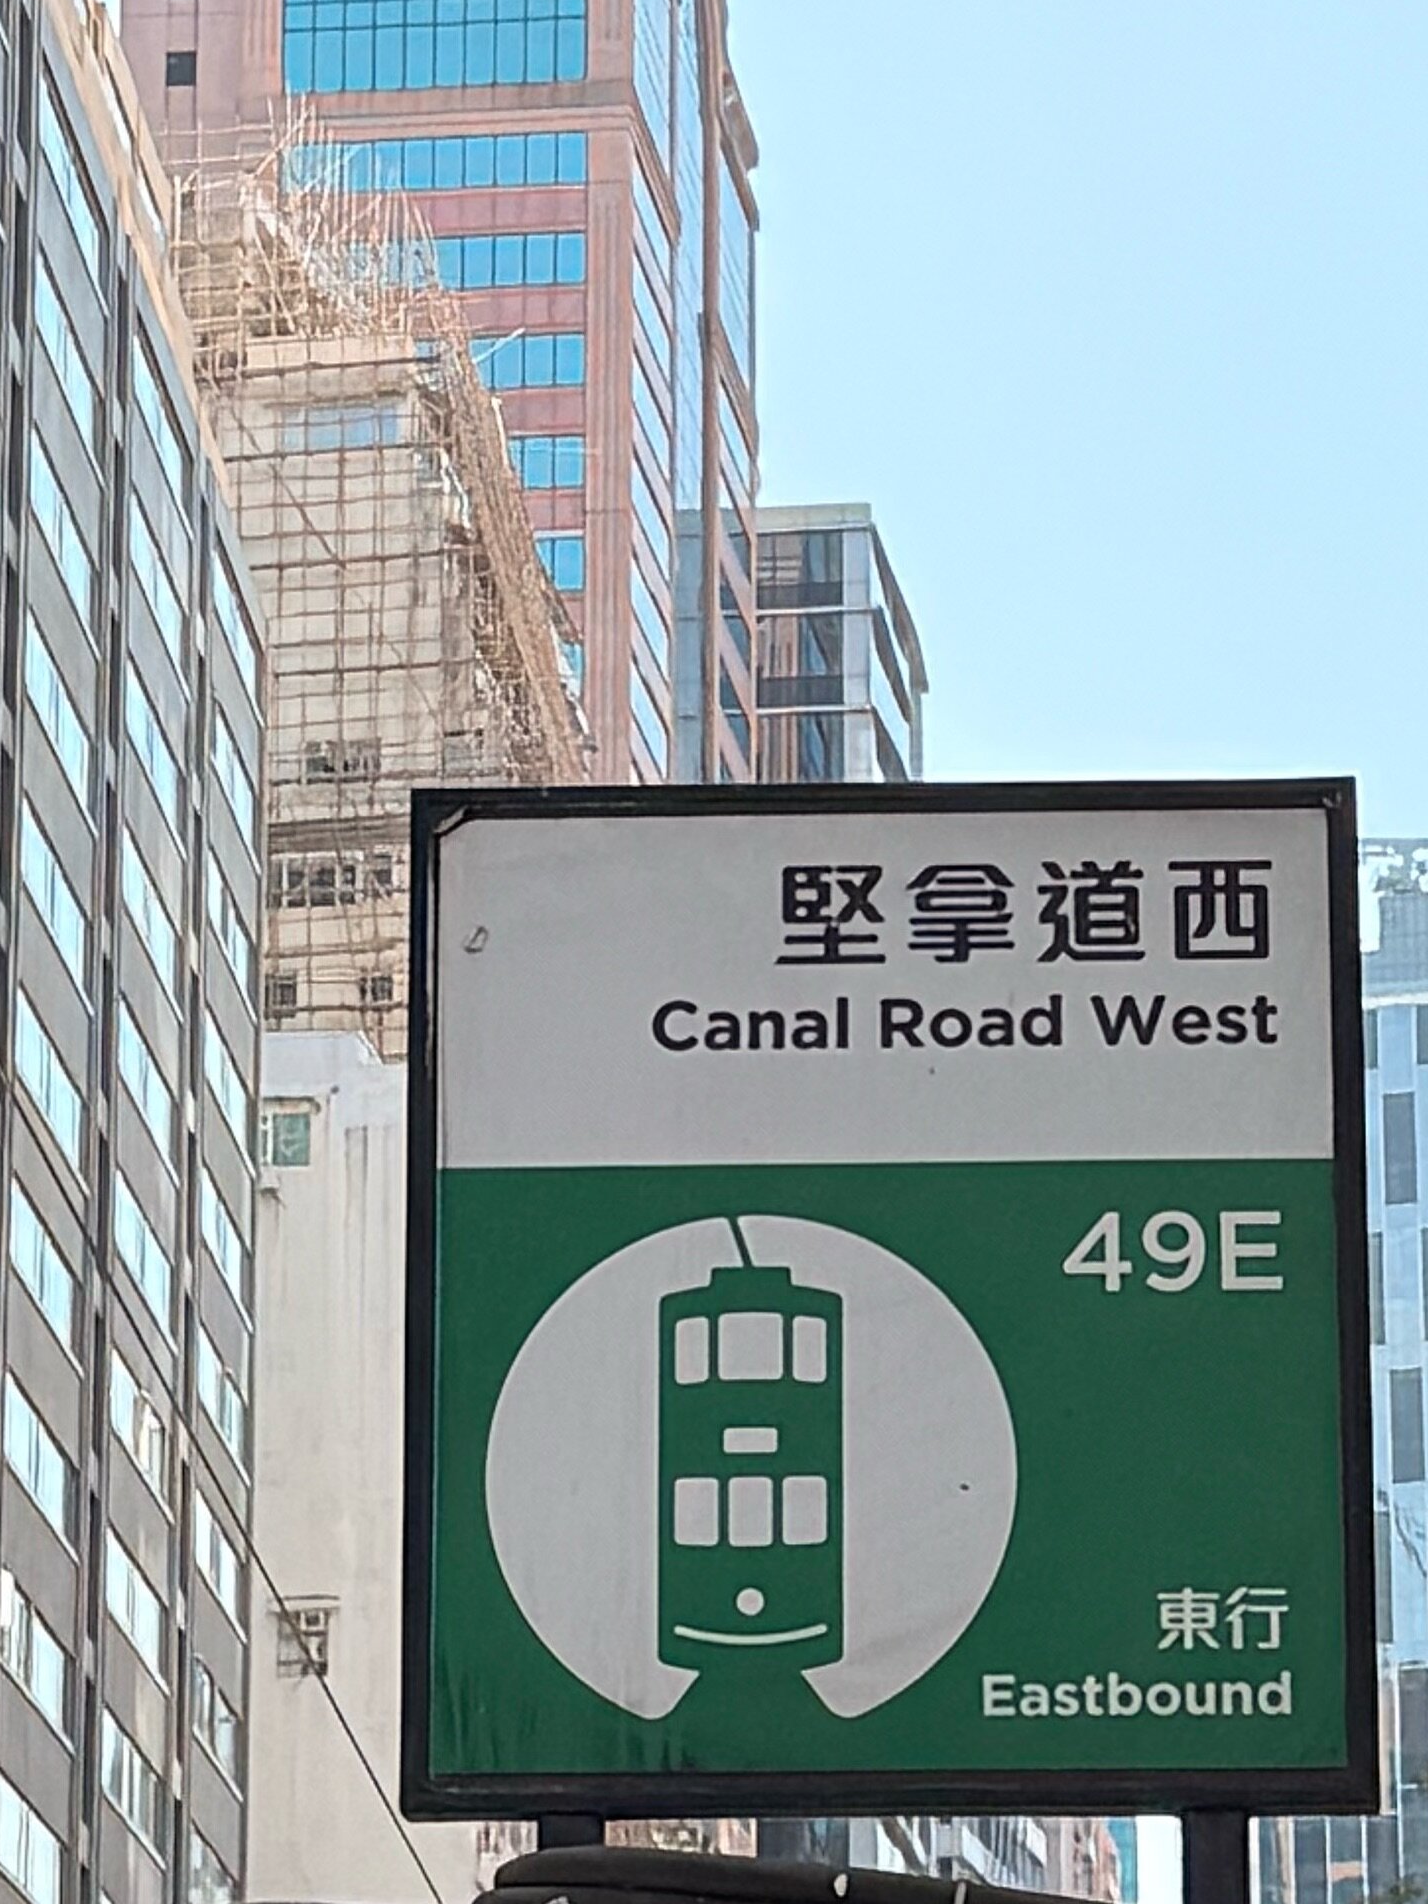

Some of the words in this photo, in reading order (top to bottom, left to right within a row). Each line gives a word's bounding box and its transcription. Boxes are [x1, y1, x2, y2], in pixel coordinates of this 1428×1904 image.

[774, 859, 1273, 965] 堅拿道西
[652, 996, 849, 1052] Canal
[879, 993, 1063, 1049] Road
[1090, 993, 1278, 1047] West
[1062, 1210, 1284, 1292] 49E
[1156, 1586, 1290, 1650] 東行
[981, 1670, 1292, 1717] Eastbound
